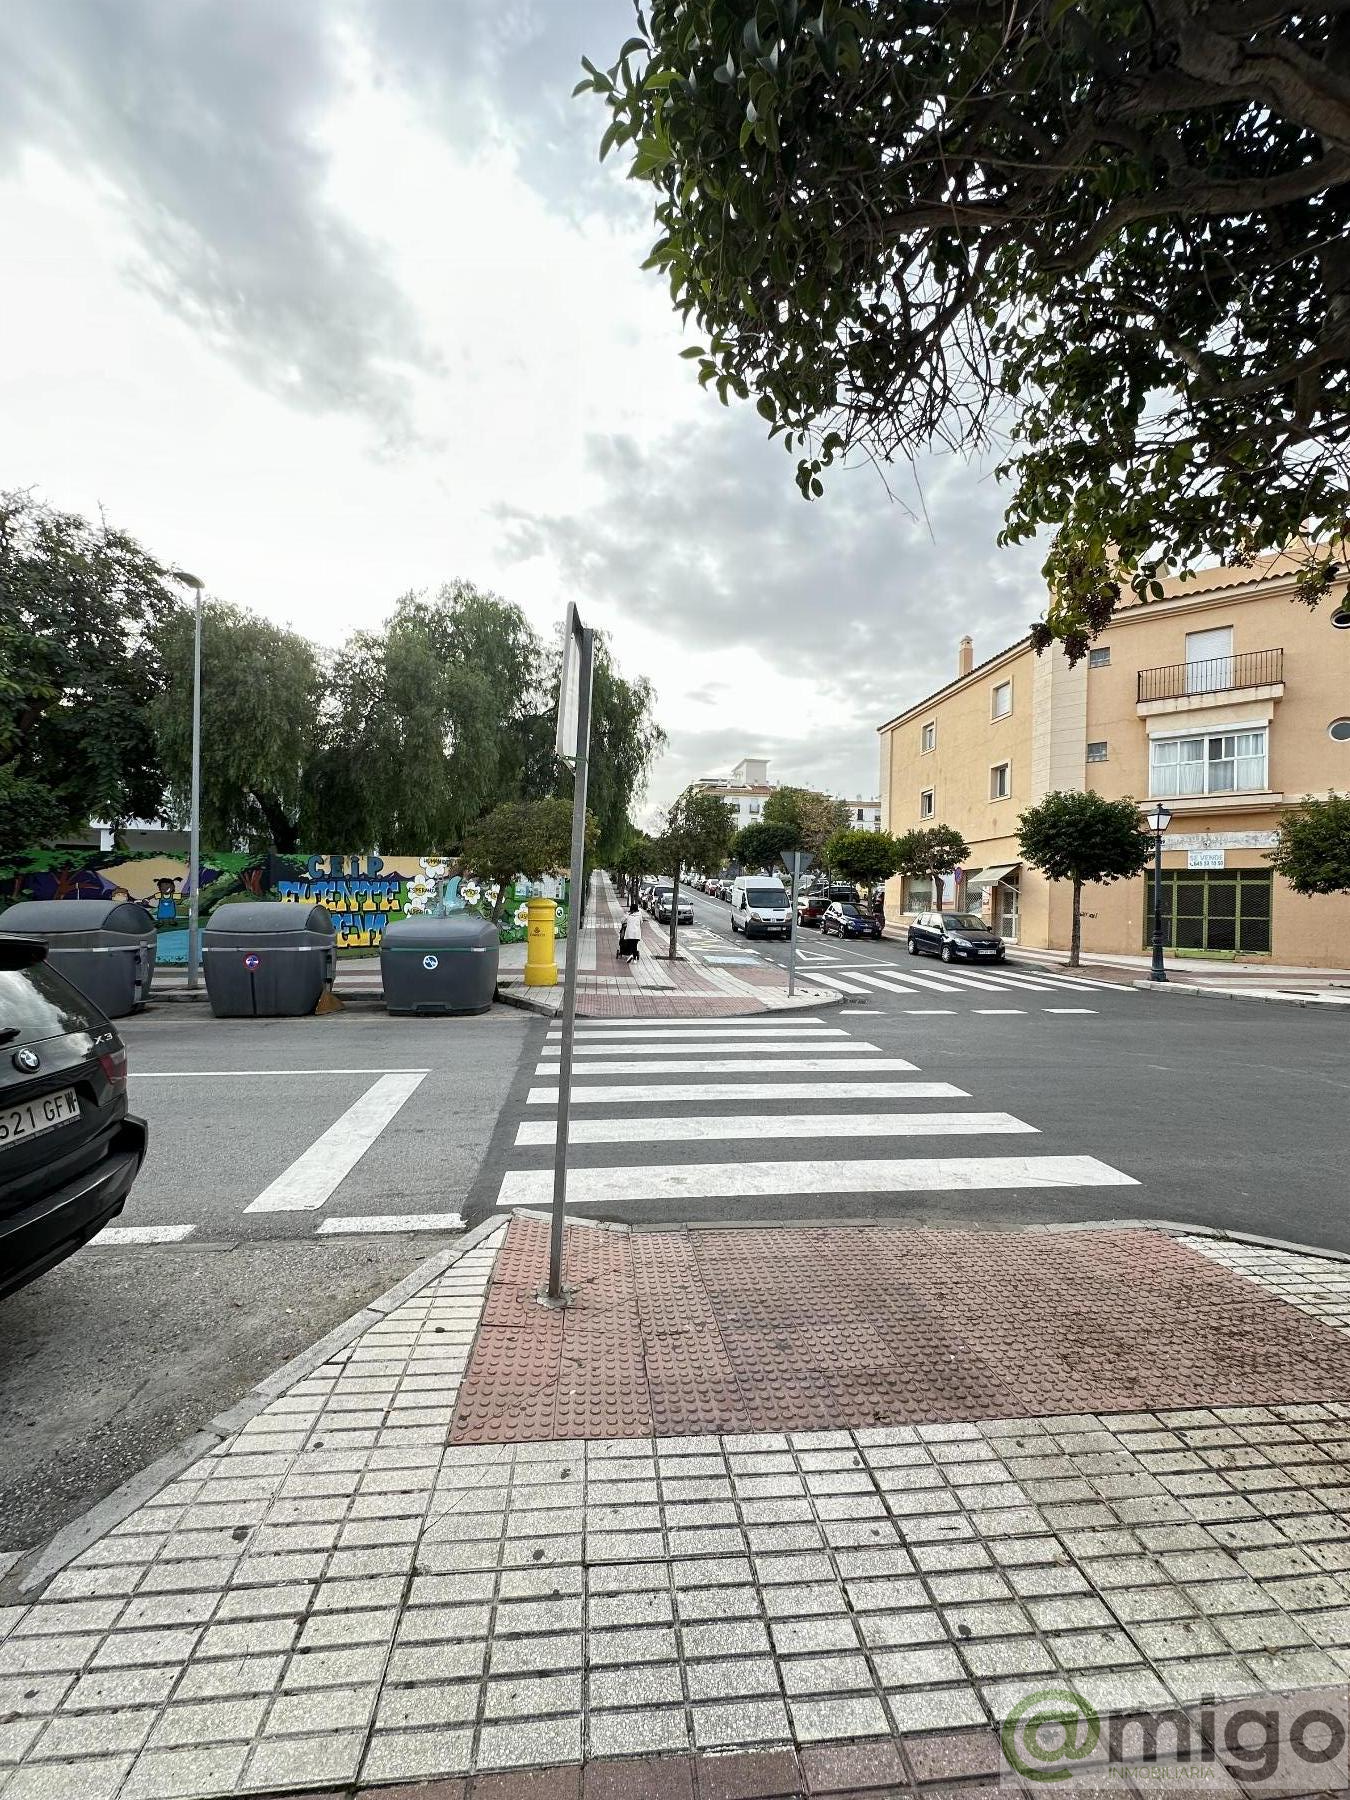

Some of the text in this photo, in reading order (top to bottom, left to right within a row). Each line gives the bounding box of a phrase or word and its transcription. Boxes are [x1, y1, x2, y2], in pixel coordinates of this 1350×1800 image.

[278, 880, 402, 912] FUENTE
[94, 1033, 112, 1044] X3
[43, 1091, 76, 1121] GFW
